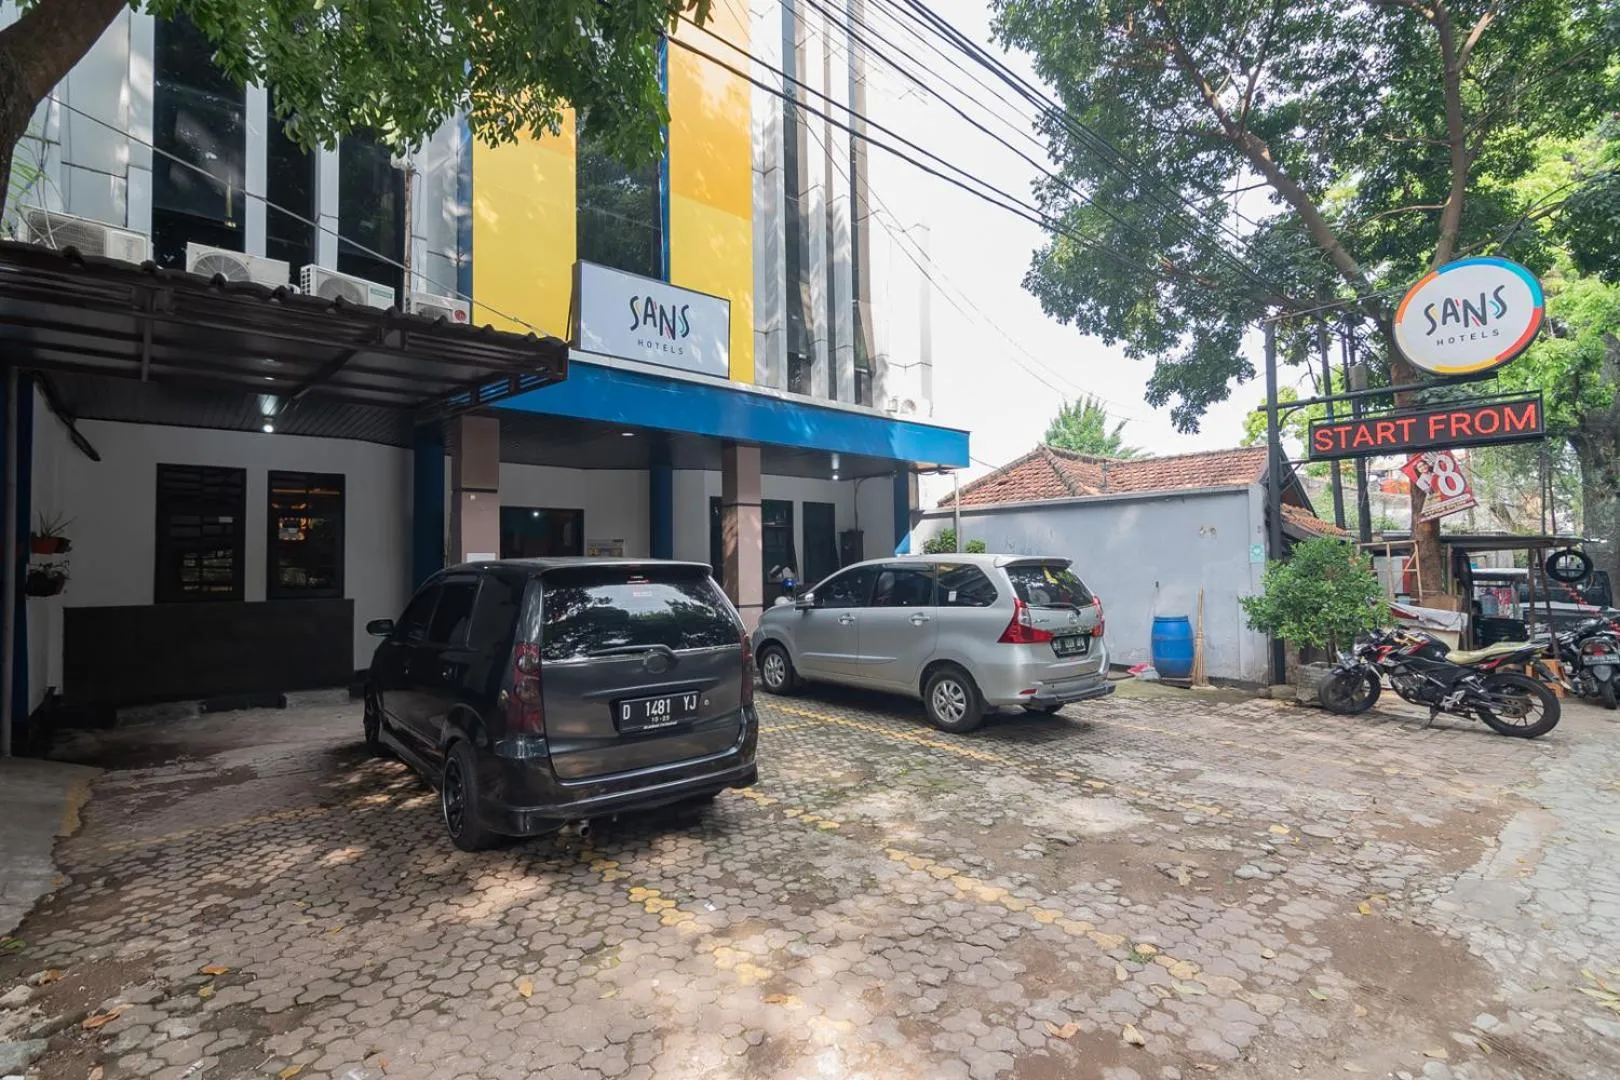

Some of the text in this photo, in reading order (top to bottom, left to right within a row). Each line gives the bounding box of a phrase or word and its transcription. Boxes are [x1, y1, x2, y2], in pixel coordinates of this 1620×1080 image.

[629, 295, 690, 341] SANS
[1424, 285, 1508, 336] SANS
[637, 338, 684, 355] HOTELS
[1436, 329, 1500, 346] HOTELS
[1314, 403, 1538, 451] START FROM
[622, 695, 697, 720] D 1481 YJ
